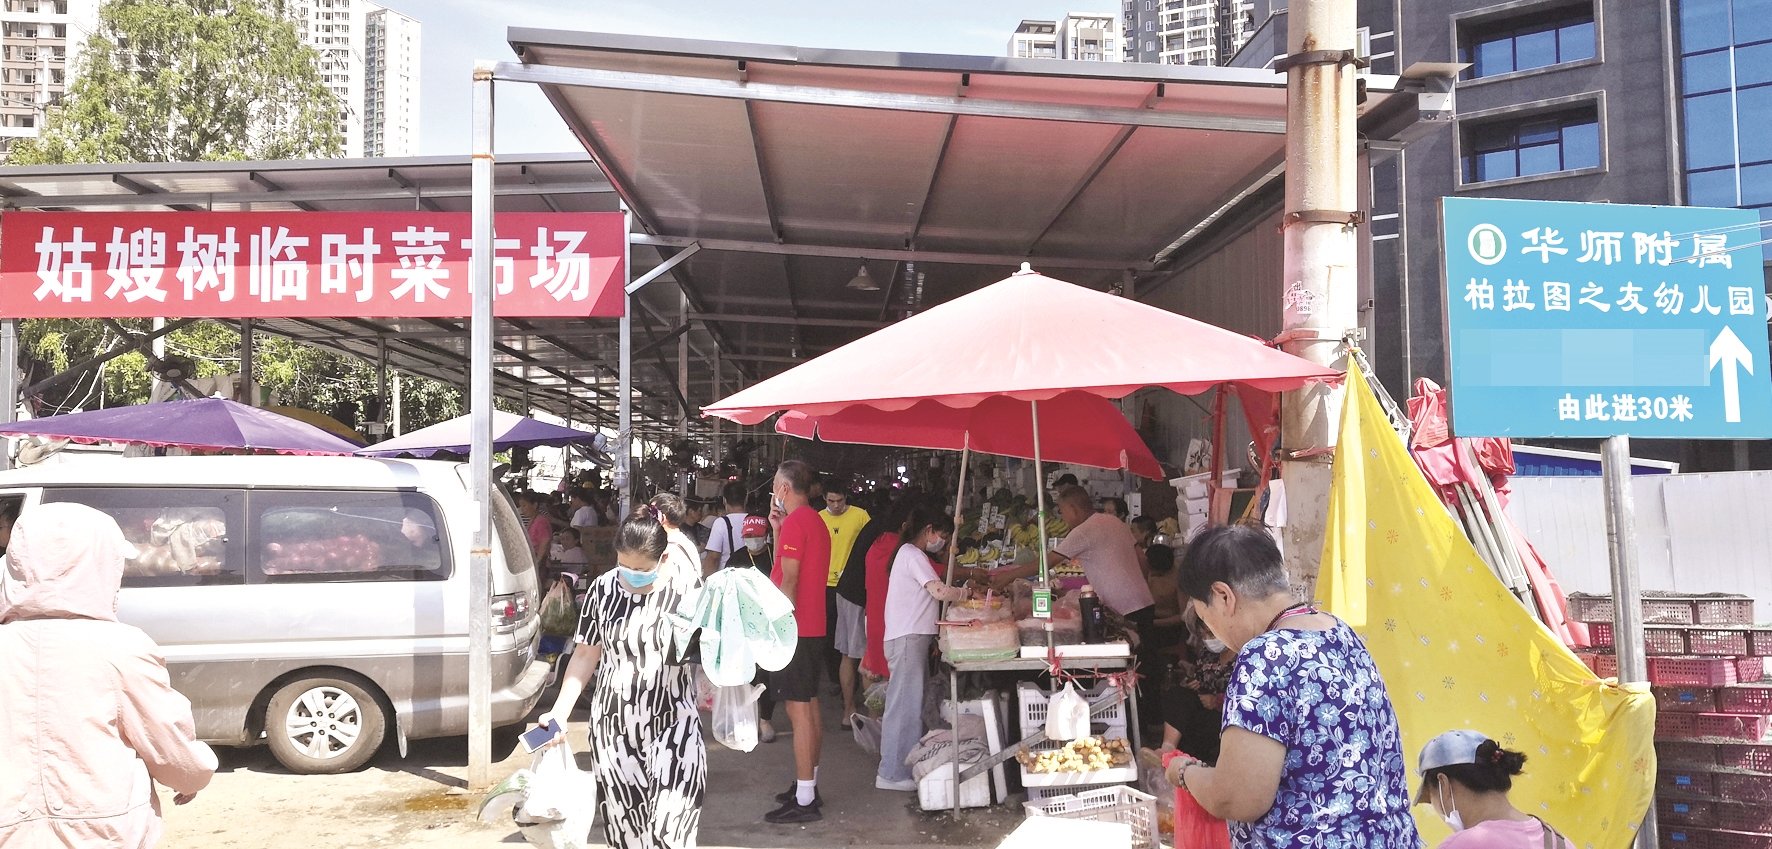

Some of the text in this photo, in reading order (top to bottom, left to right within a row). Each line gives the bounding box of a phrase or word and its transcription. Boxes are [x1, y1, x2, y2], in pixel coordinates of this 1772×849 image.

[33, 226, 591, 303] 姑嫂树临时菜市场
[1521, 226, 1734, 269] 华师附属
[1464, 277, 1755, 316] 柏拉图之友幼儿园
[1558, 393, 1694, 422] 由此进30米
